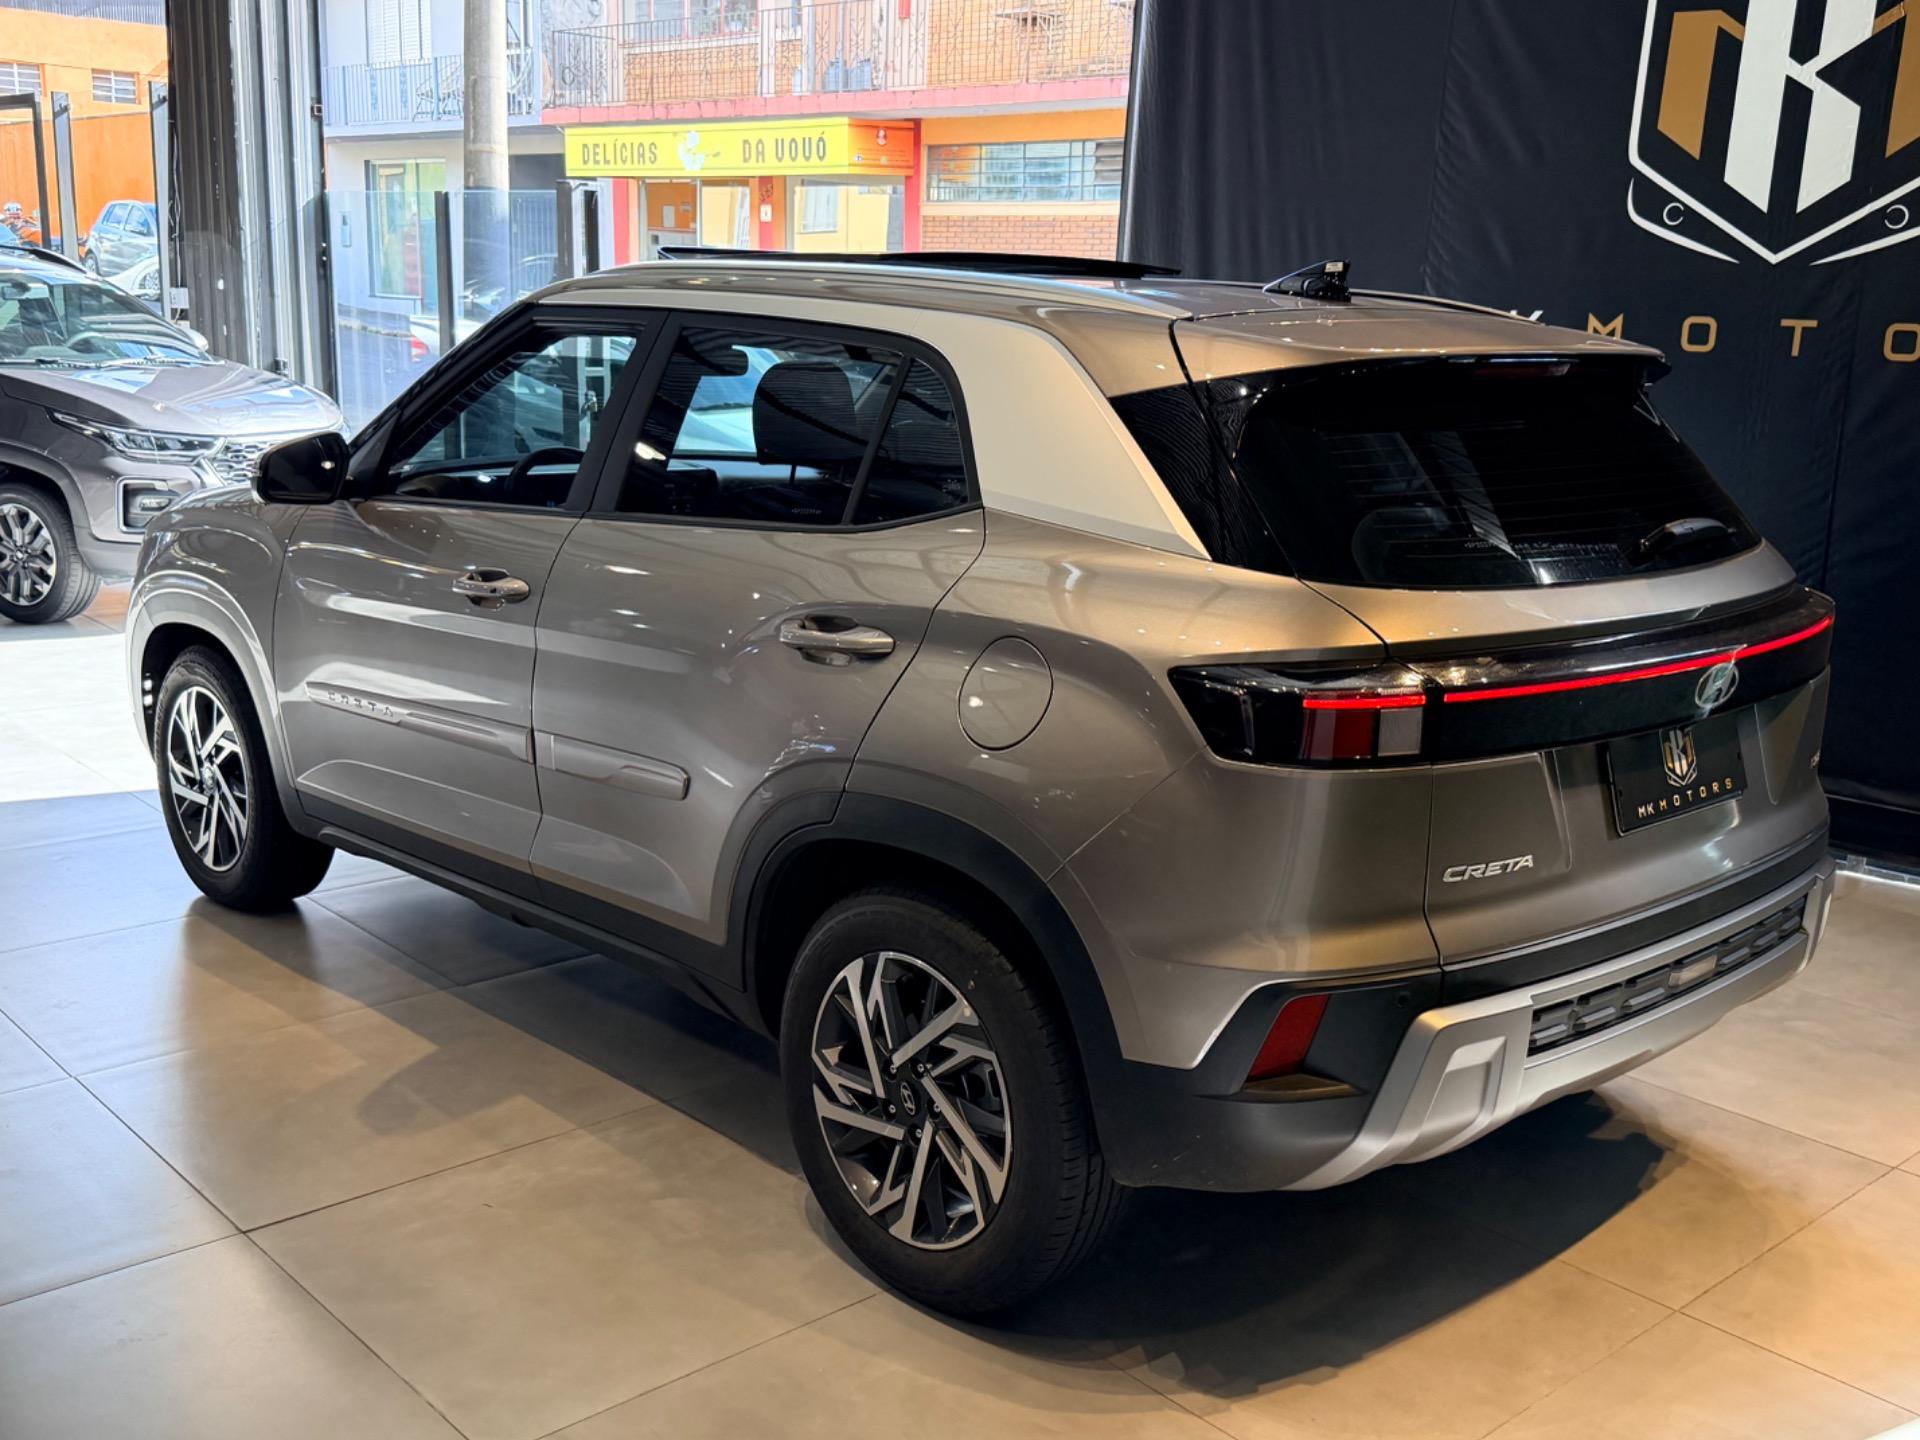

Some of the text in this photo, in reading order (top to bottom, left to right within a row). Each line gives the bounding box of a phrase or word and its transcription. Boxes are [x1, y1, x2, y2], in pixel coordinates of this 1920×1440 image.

[582, 138, 657, 166] DELÍCIAS
[742, 139, 765, 163] DA
[1638, 778, 1733, 818] MK MOTORS
[1443, 855, 1533, 882] CRETA
